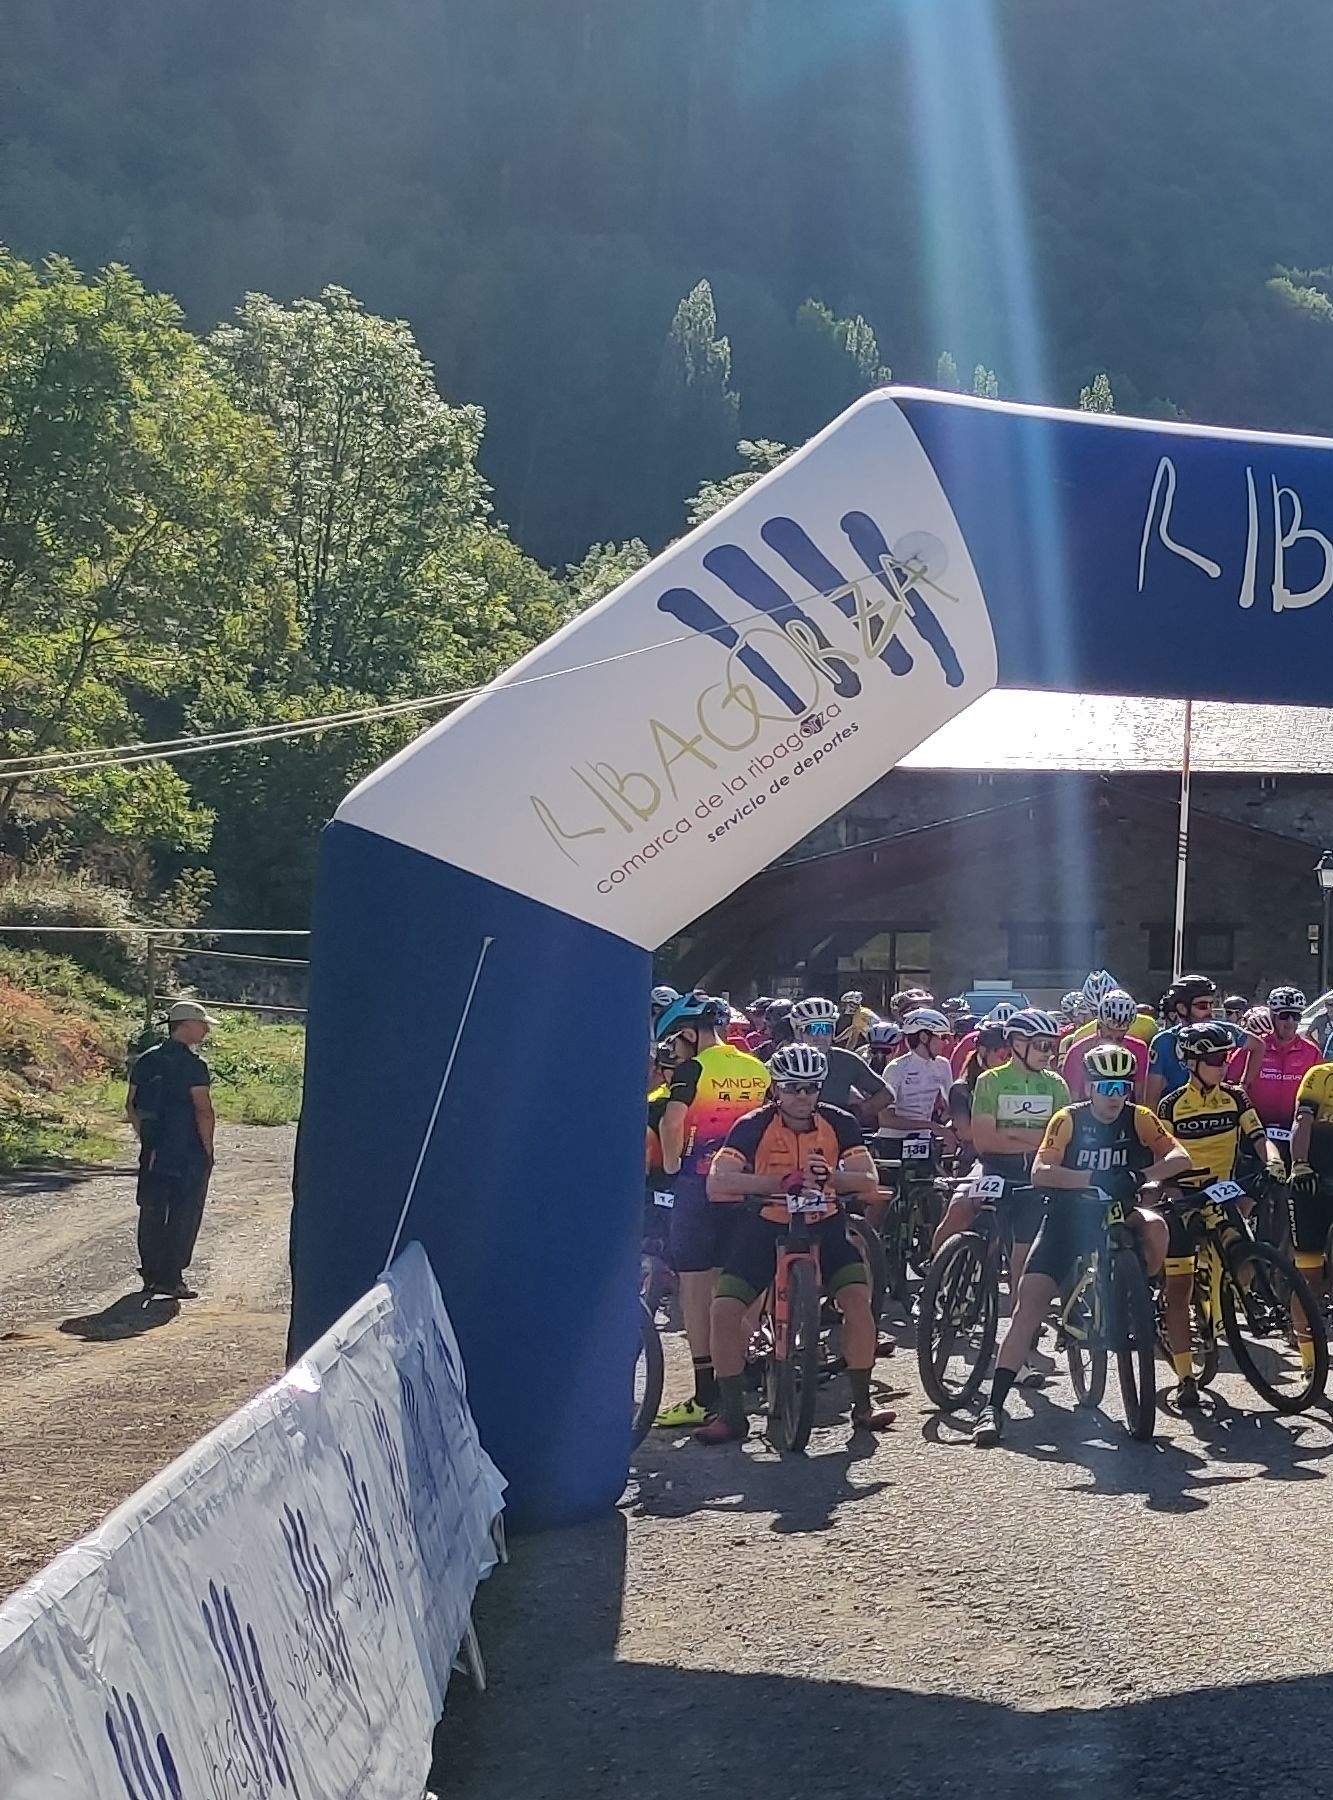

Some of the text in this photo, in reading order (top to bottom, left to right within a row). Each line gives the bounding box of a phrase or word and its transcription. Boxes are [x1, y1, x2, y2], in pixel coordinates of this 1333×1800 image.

[706, 721, 860, 843] servicio de deportes
[597, 703, 842, 894] comarca de la ribagorza
[1076, 1147, 1129, 1171] PEDAL
[975, 1180, 1000, 1193] 142
[1211, 1184, 1239, 1199] 123
